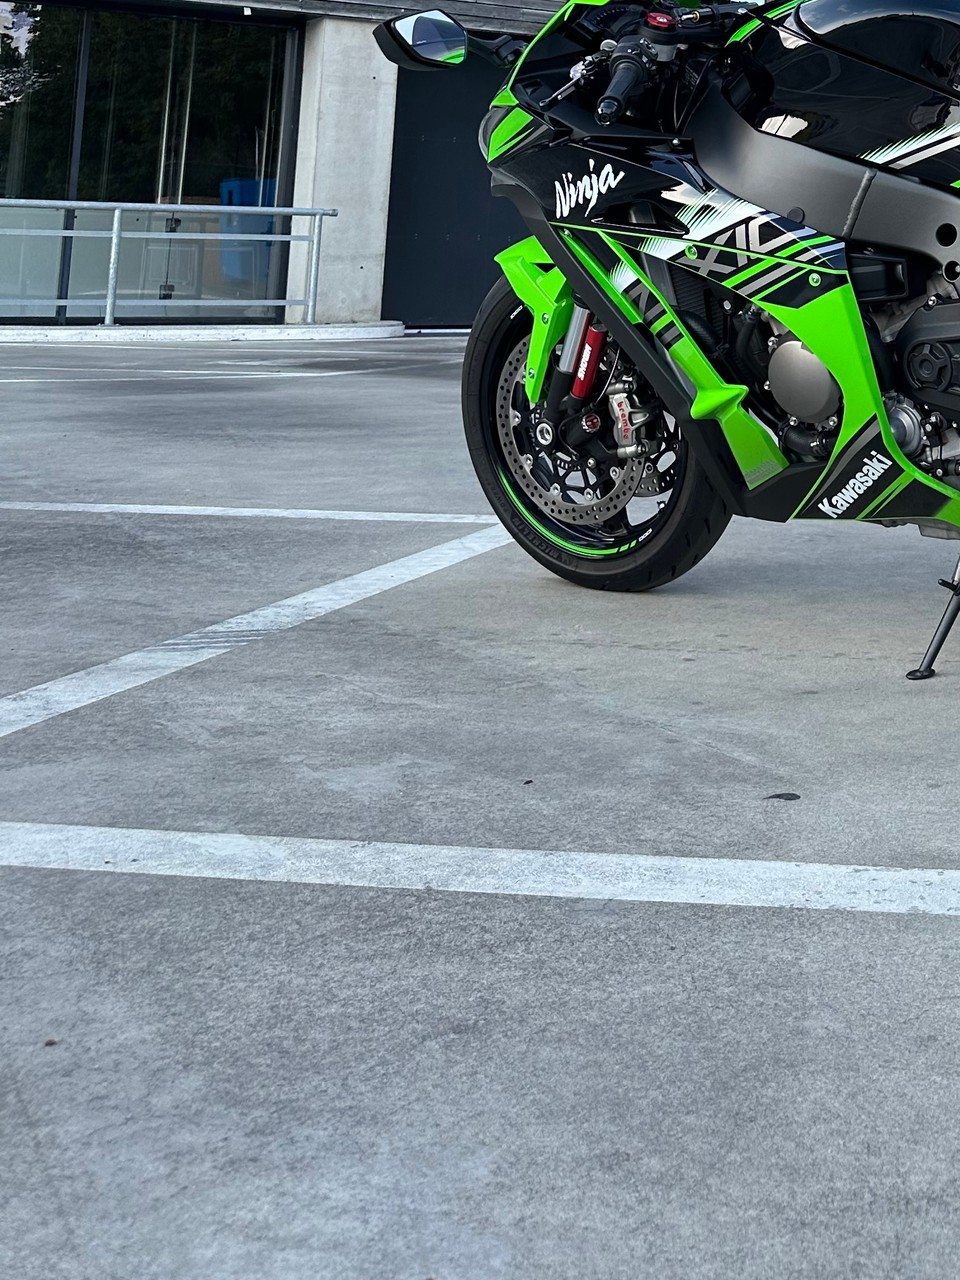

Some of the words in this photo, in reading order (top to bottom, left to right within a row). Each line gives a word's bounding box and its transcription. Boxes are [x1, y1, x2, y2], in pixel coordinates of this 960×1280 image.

[555, 158, 625, 218] Ninja
[577, 343, 592, 381] SHOWA
[817, 450, 893, 518] Kawasaki
[512, 517, 560, 559] MICHELIN
